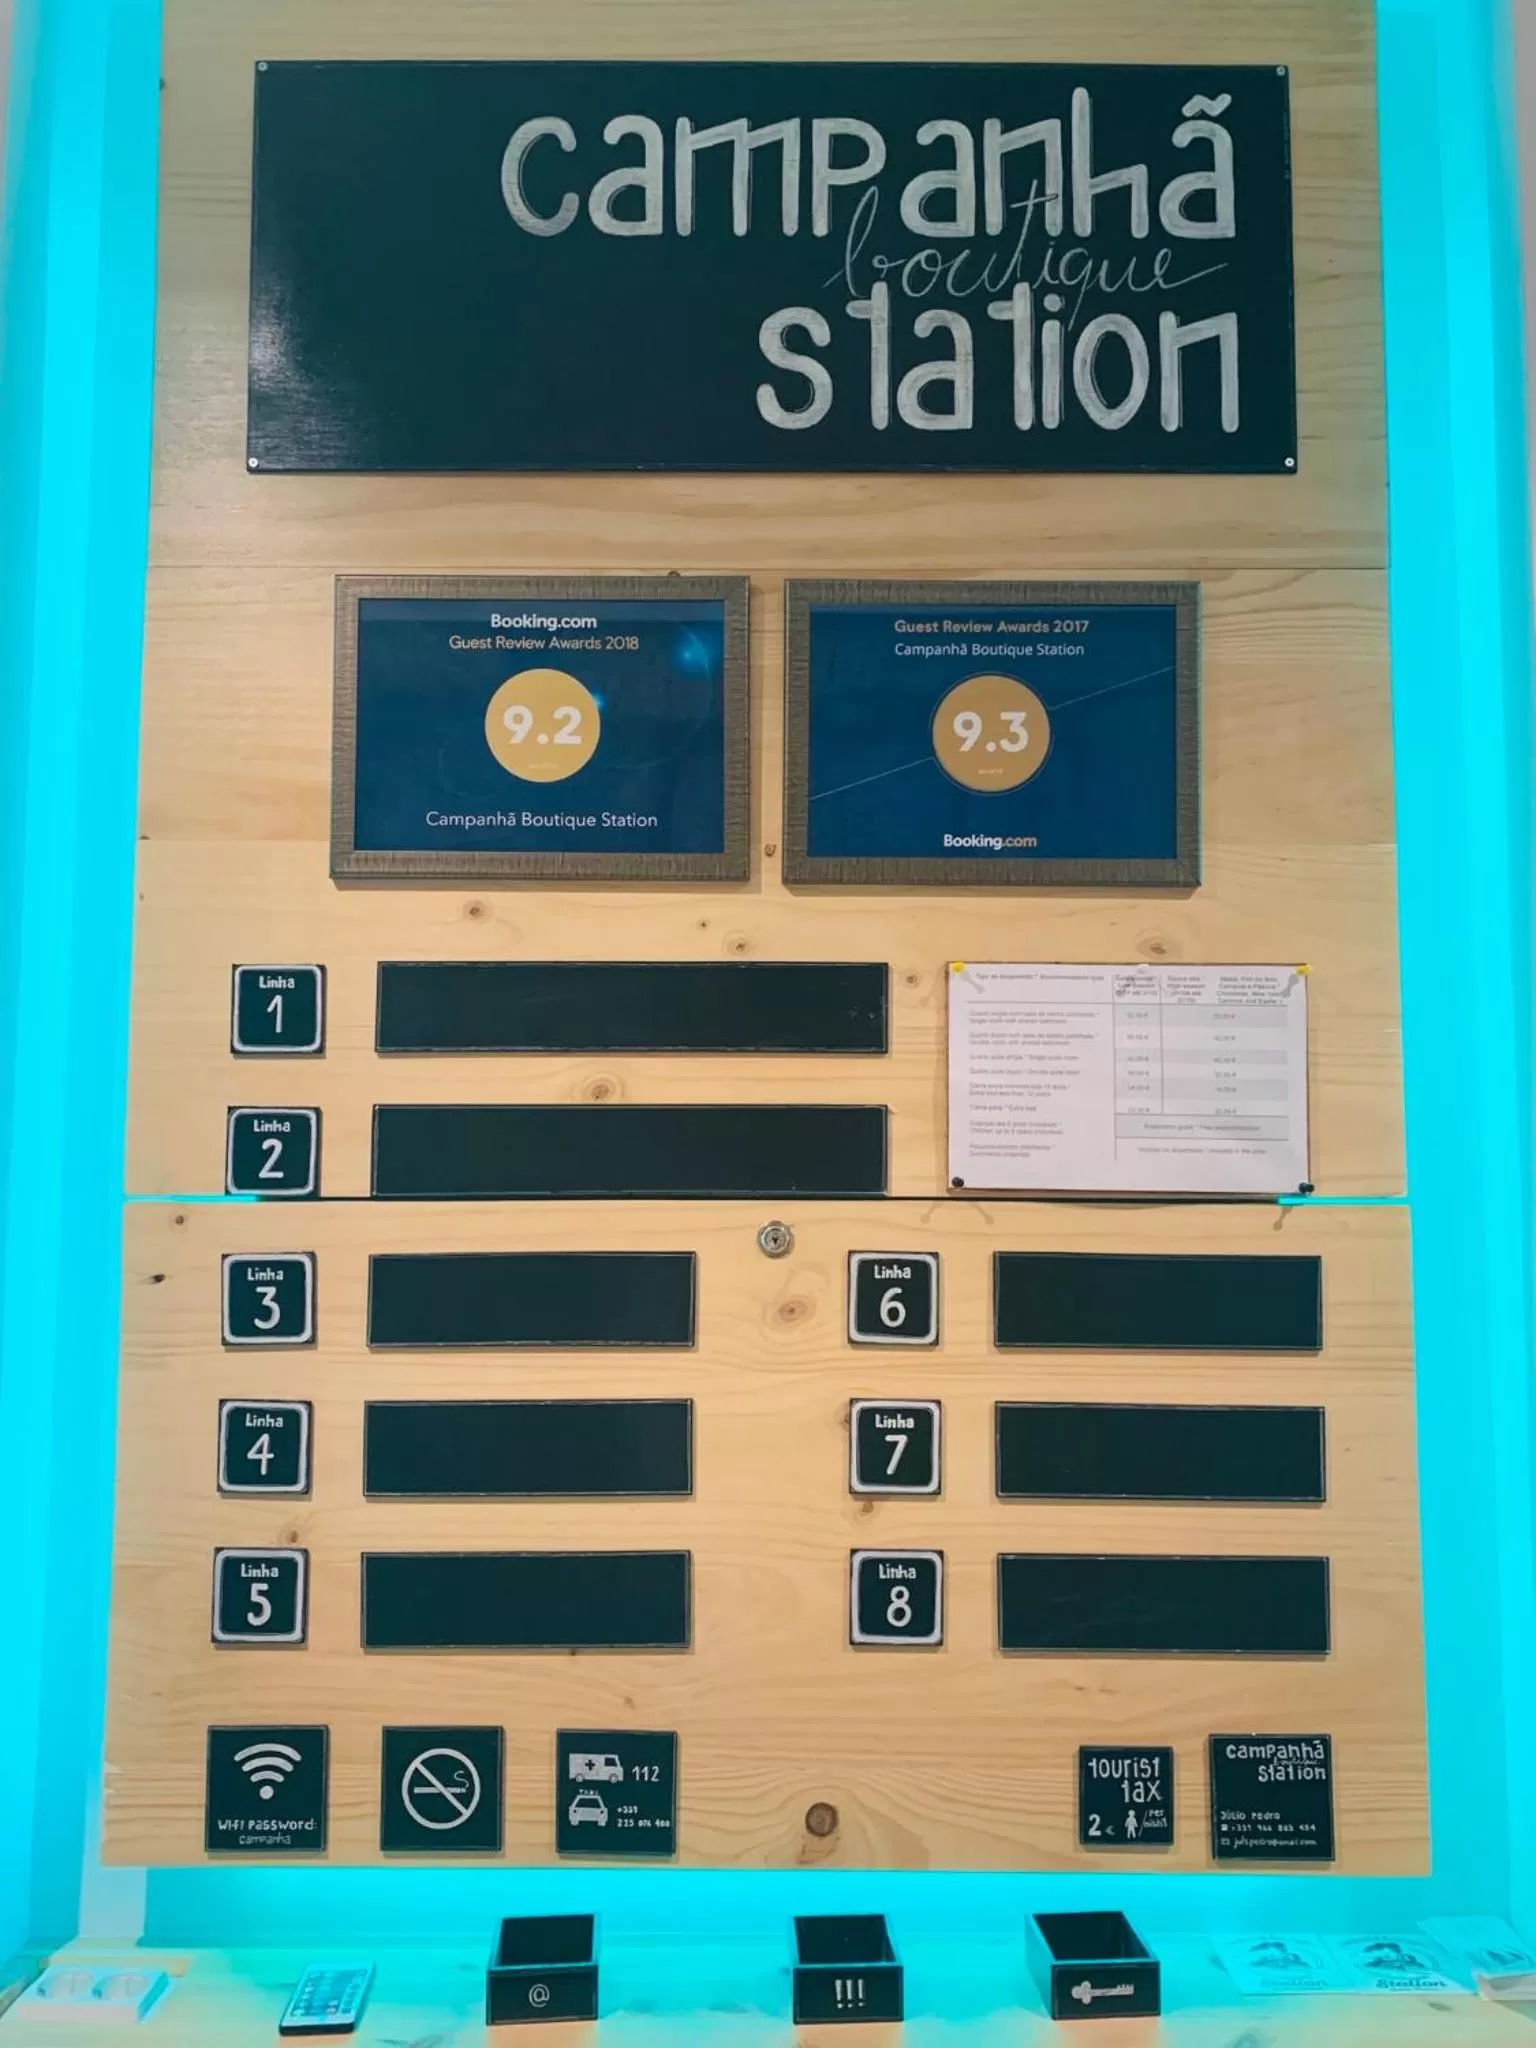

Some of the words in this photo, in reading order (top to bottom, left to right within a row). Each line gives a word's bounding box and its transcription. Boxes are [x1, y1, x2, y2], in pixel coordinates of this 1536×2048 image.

[501, 87, 1237, 238] campanhã
[823, 179, 1229, 334] boutique
[756, 281, 1240, 432] station
[490, 613, 597, 632] Booking.com
[894, 620, 938, 634] Guest
[943, 620, 993, 634] Review
[997, 620, 1049, 634] Awards
[1053, 620, 1089, 633] 2017
[449, 636, 492, 650] Guest
[496, 636, 545, 650] Review
[549, 636, 602, 650] Awards
[605, 636, 640, 650] 2018
[894, 642, 968, 658] Campanhã
[971, 643, 1033, 658] Boutique
[1037, 643, 1085, 656] Station
[503, 705, 582, 744] 9.2
[952, 711, 1029, 752] 9.3
[426, 811, 516, 828] Campanhã
[521, 811, 597, 828] Boutique
[601, 812, 658, 827] Station
[943, 834, 1038, 850] Booking.com
[259, 975, 295, 989] Linha
[267, 995, 282, 1033] 1
[253, 1119, 291, 1133] Linha
[258, 1138, 284, 1179] 2
[246, 1267, 283, 1282] Linha
[874, 1264, 911, 1279] Linha
[253, 1286, 281, 1330] 3
[880, 1287, 906, 1328] 6
[245, 1413, 283, 1428] Linha
[875, 1413, 914, 1429] Linha
[247, 1433, 274, 1476] 4
[884, 1434, 909, 1475] 7
[240, 1563, 279, 1578] Linha
[878, 1564, 916, 1579] Linha
[246, 1583, 272, 1627] 5
[886, 1586, 912, 1627] 8
[632, 1766, 660, 1782] 112
[1088, 1757, 1160, 1779] tourist
[1121, 1780, 1162, 1803] tax
[1088, 1813, 1102, 1836] 2
